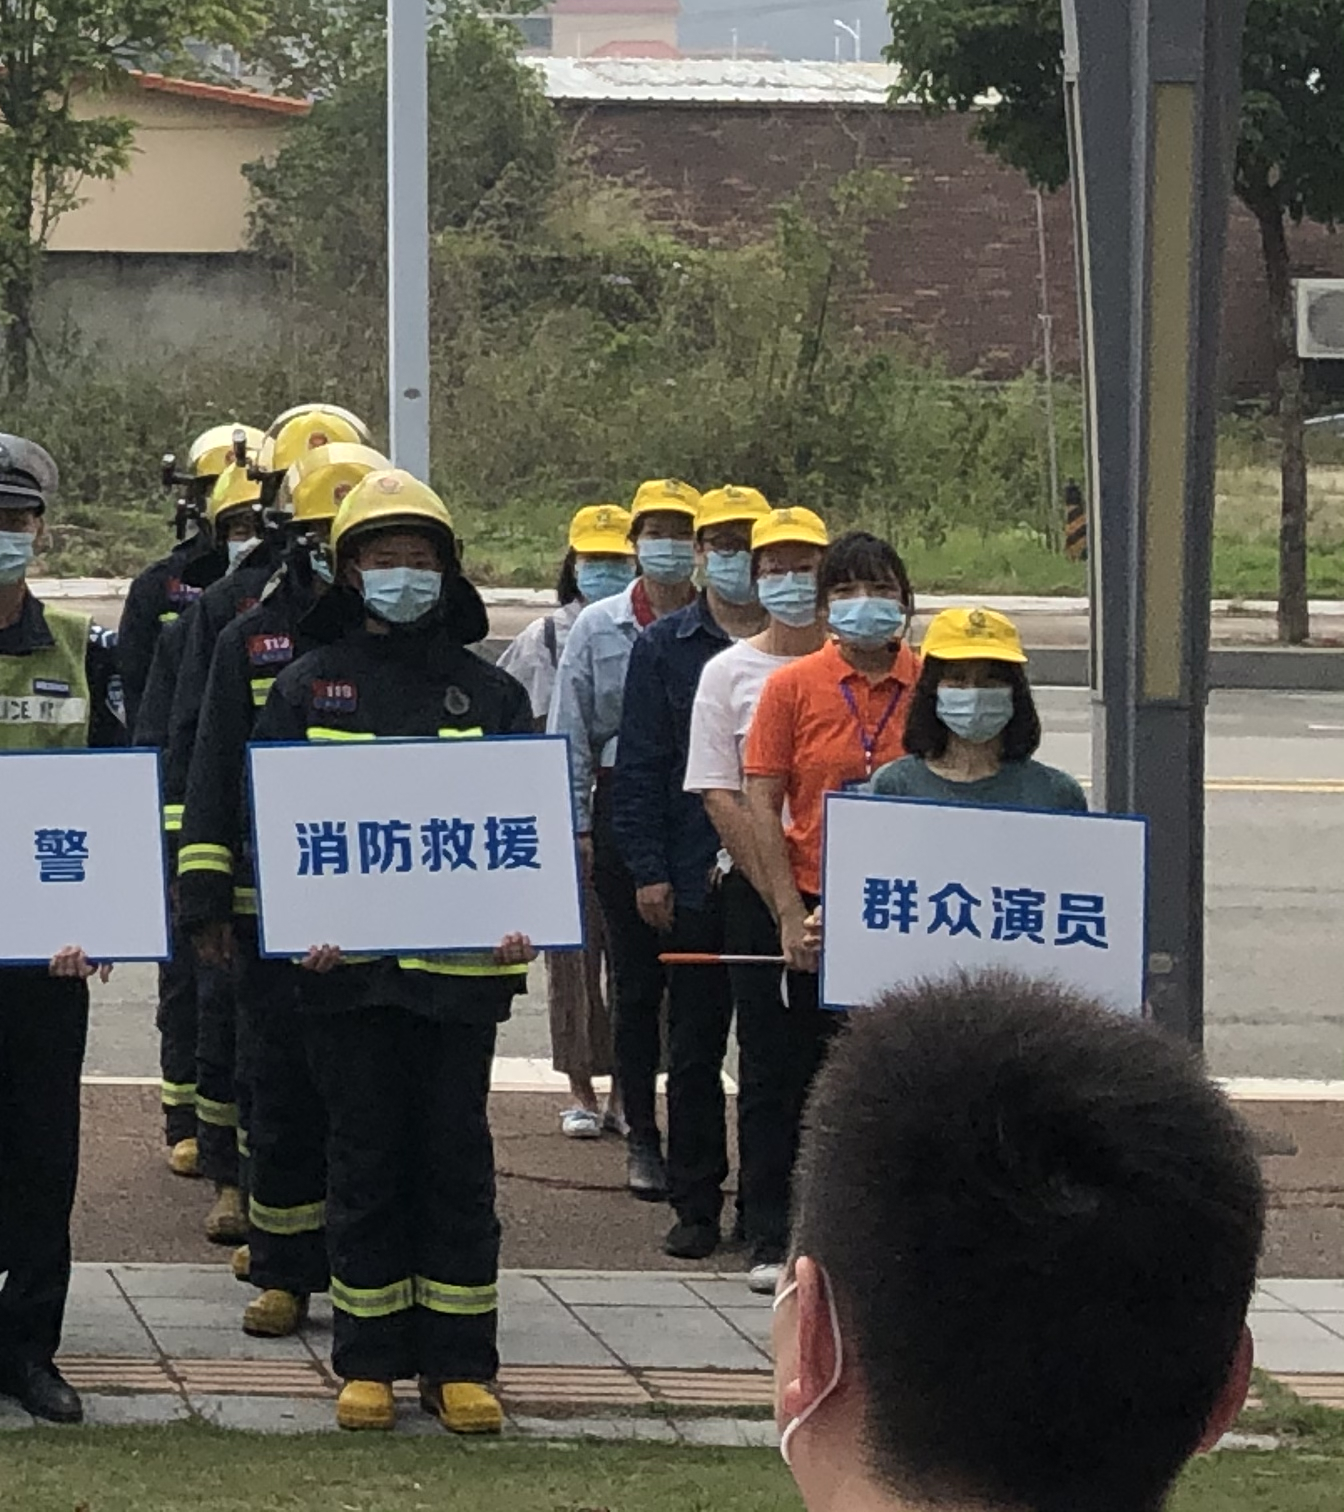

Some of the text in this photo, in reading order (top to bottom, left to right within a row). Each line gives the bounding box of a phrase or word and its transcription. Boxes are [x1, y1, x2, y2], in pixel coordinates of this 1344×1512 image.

[295, 815, 542, 876] 消防救援
[862, 877, 1109, 949] 群众演员
